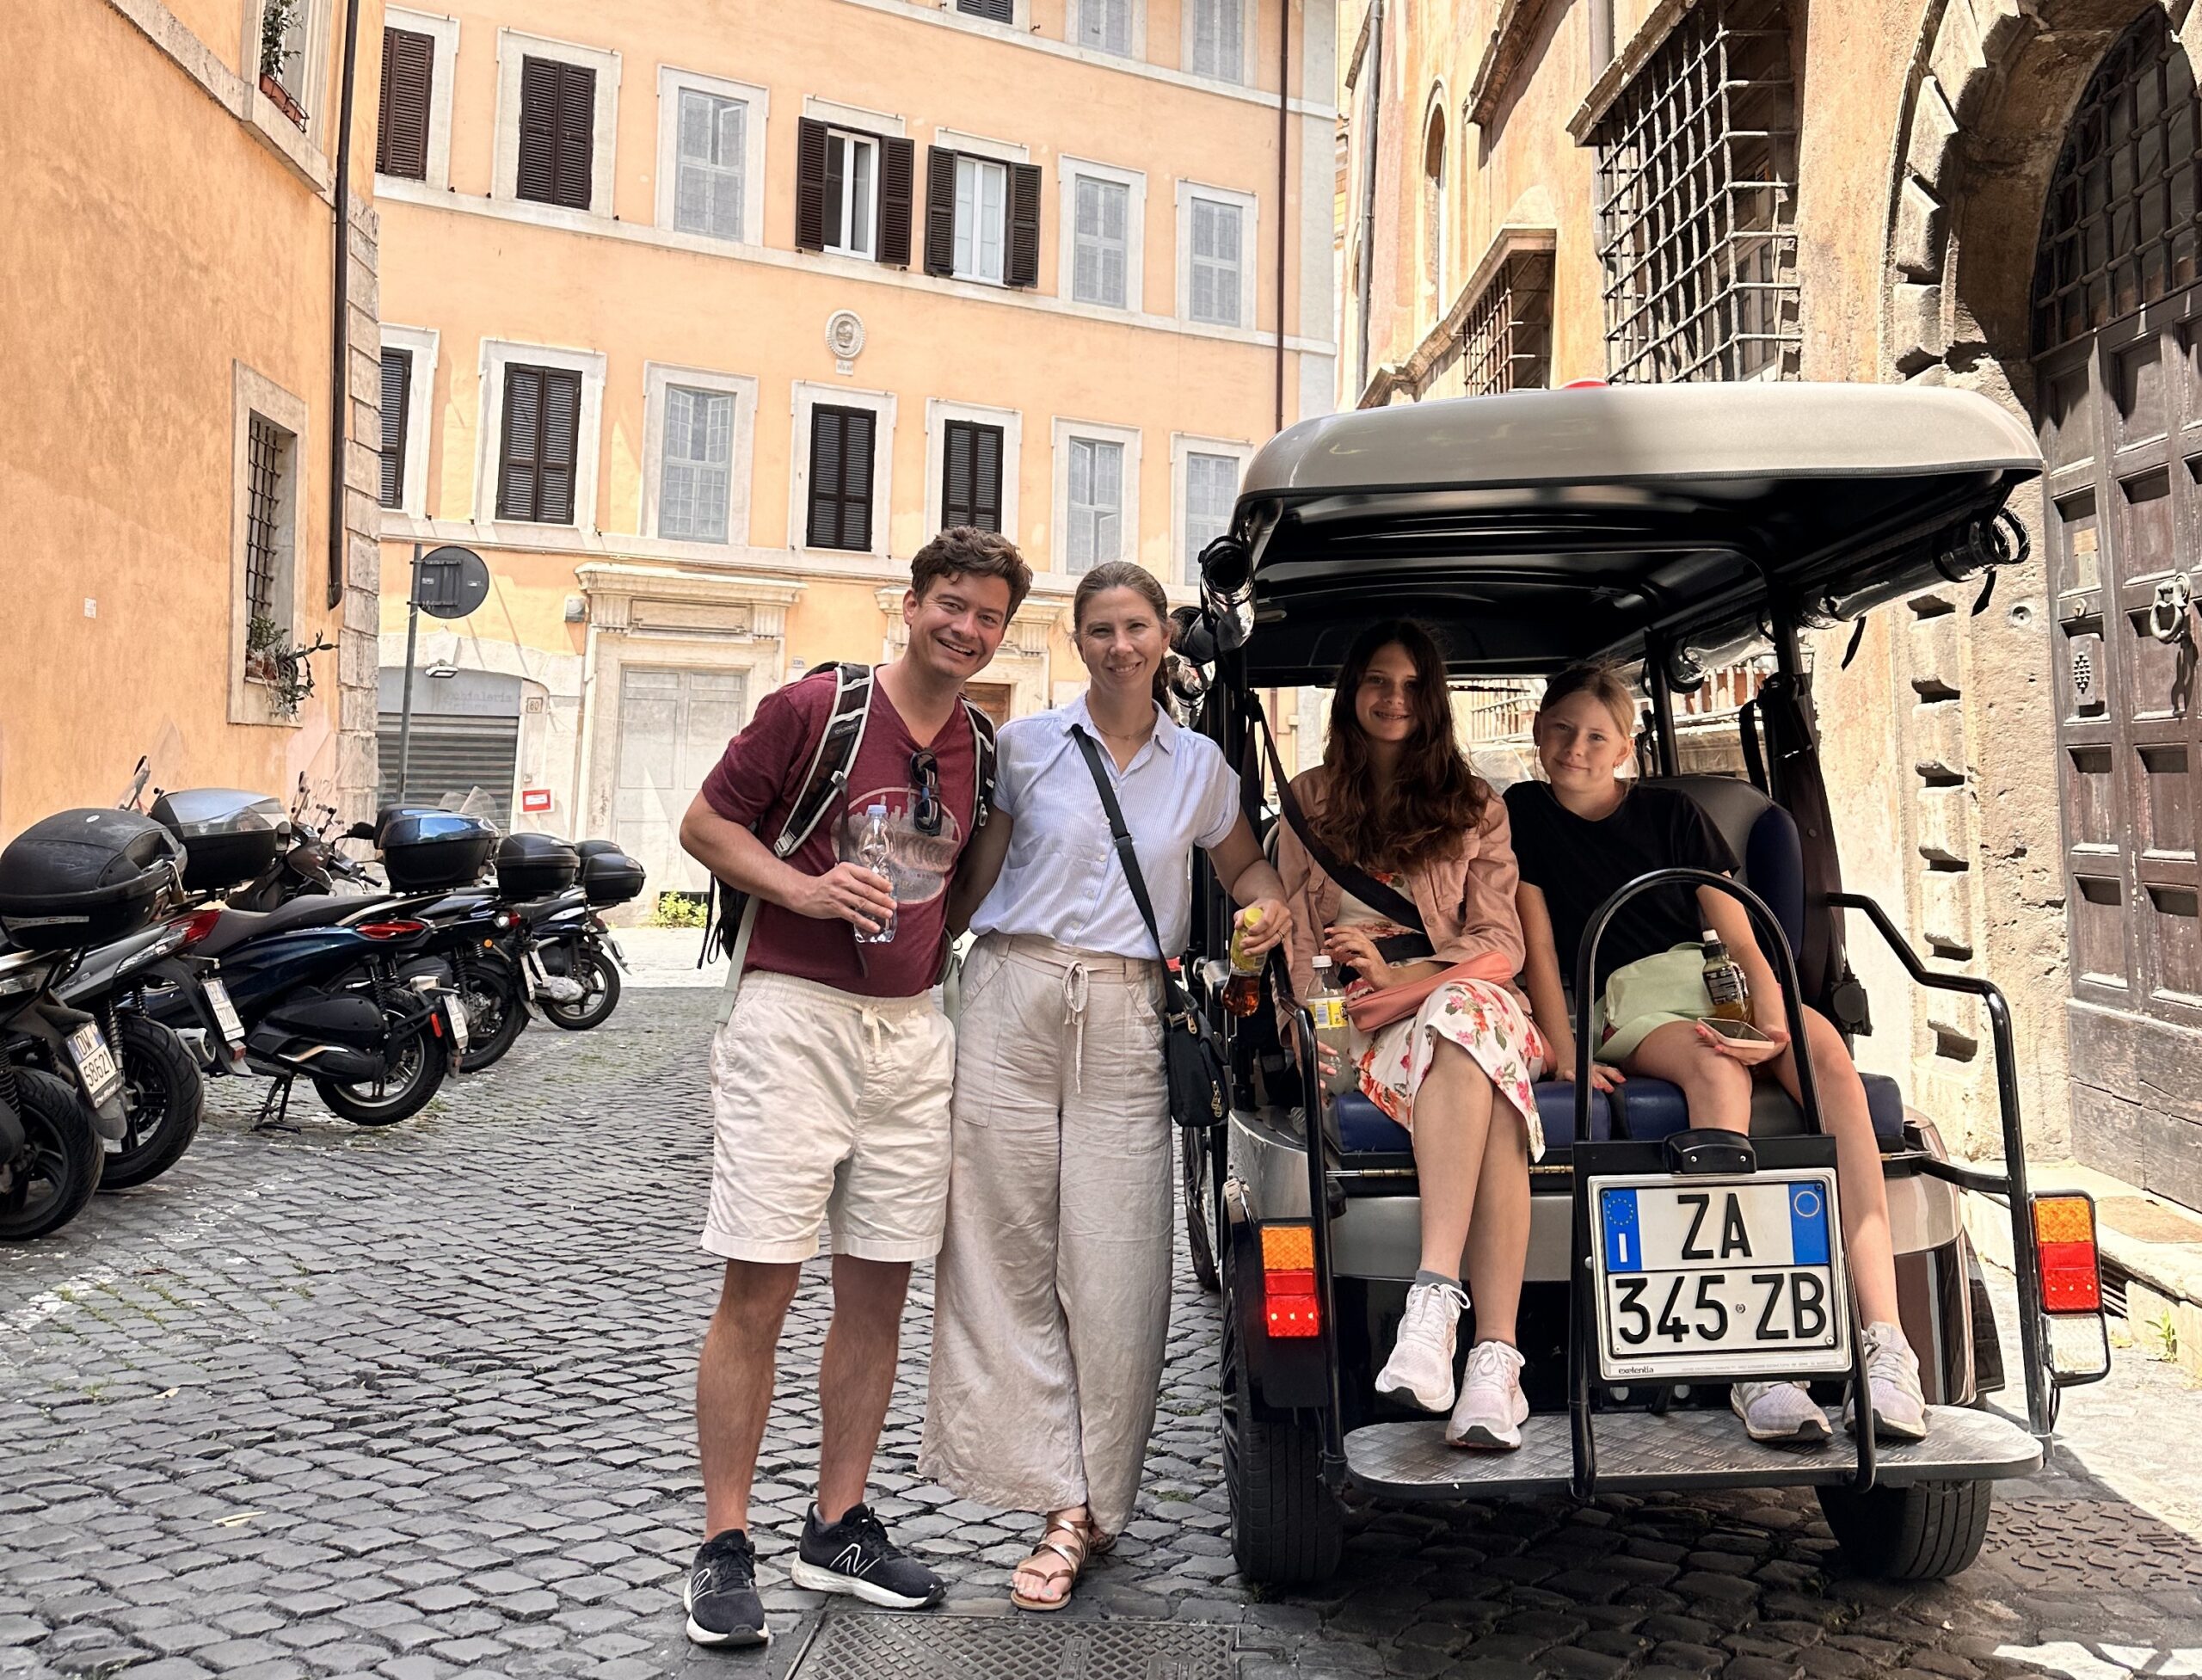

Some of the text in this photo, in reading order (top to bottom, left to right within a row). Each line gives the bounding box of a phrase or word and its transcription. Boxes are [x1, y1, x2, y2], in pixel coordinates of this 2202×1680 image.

[83, 1049, 114, 1086] 58621
[1618, 1232, 1628, 1264] I
[1677, 1192, 1753, 1260] ZA
[1615, 1271, 1828, 1345] 345 ZB
